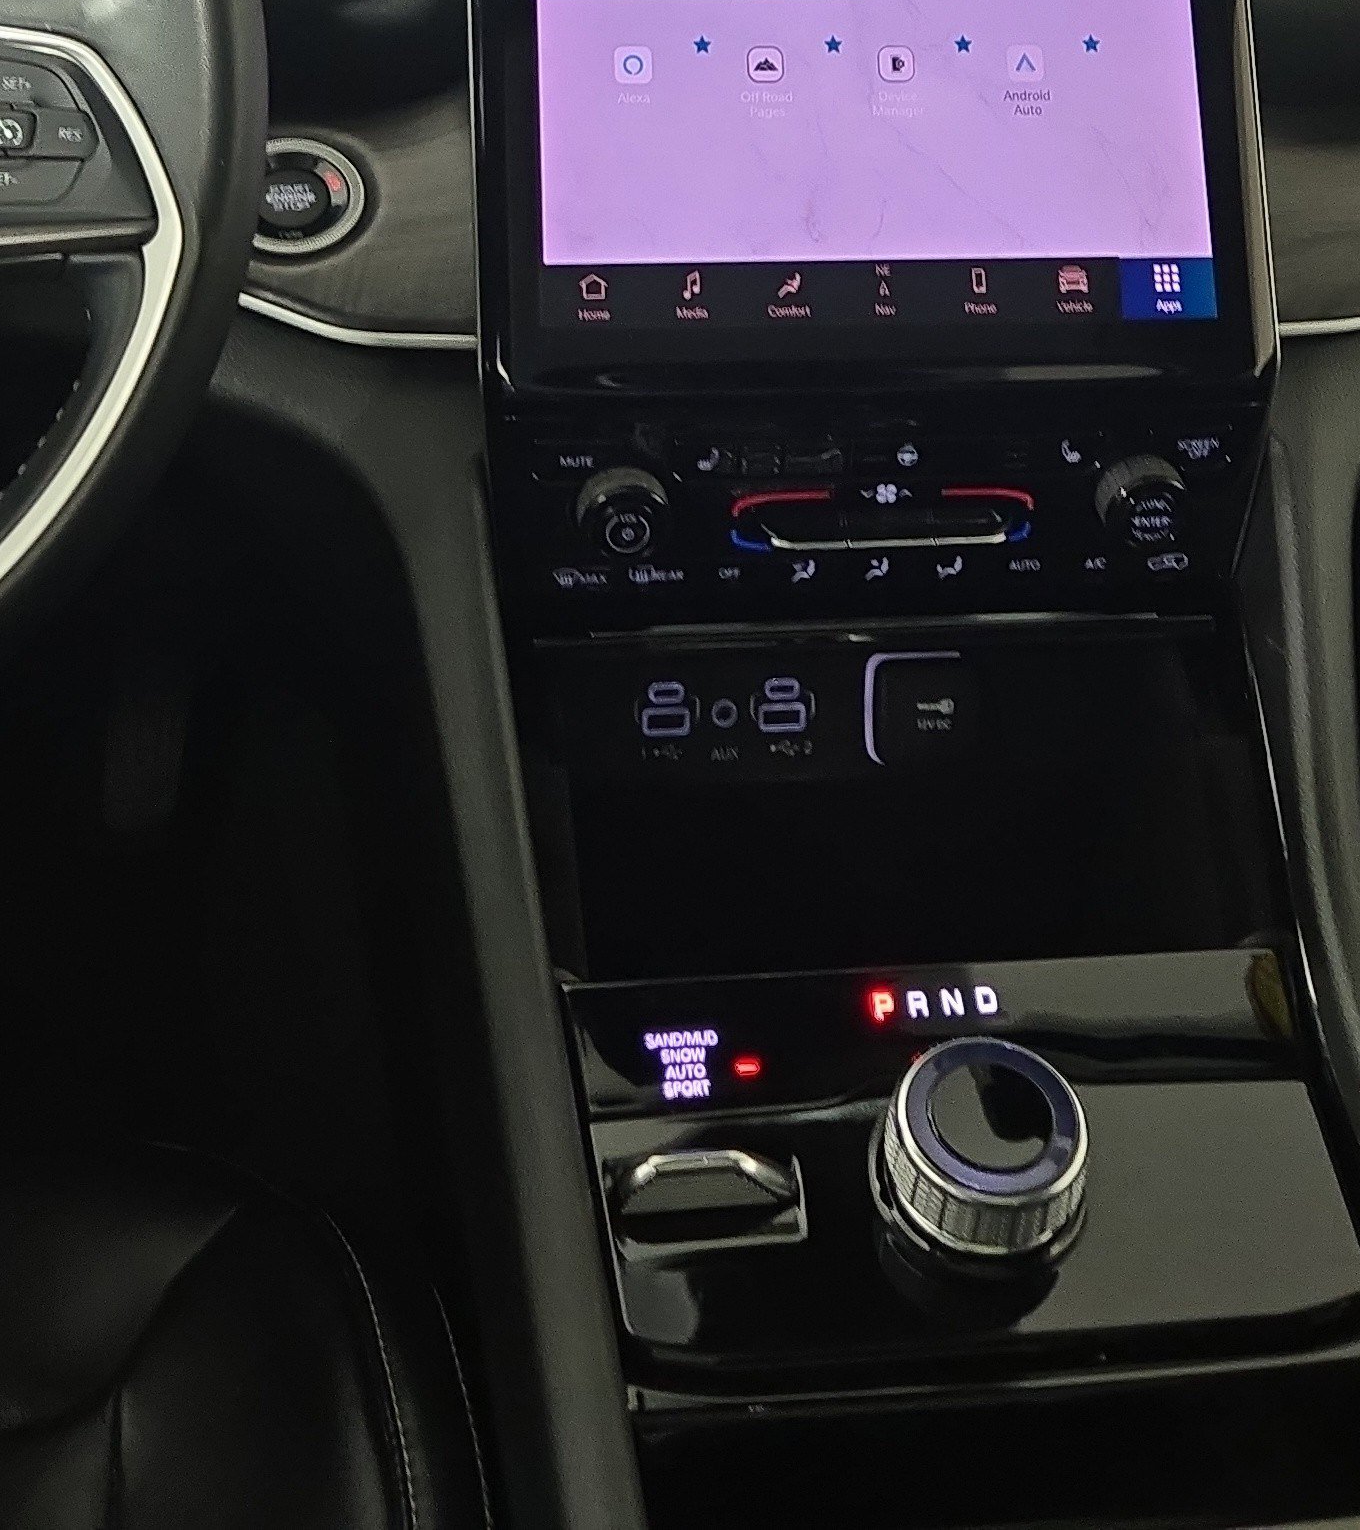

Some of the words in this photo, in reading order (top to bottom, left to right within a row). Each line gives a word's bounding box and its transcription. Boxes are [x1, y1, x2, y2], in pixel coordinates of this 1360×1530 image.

[617, 92, 651, 105] Alexa
[1003, 89, 1051, 103] Android
[1013, 103, 1043, 117] Auto
[767, 303, 812, 319] Comfort
[1155, 298, 1183, 316] Apps
[872, 991, 895, 1020] P
[906, 990, 929, 1019] R
[939, 988, 966, 1017] N
[974, 986, 998, 1015] D
[644, 1030, 718, 1050] SAND/MUD
[661, 1047, 706, 1064] SNOW
[665, 1063, 707, 1080] AUTO
[663, 1079, 711, 1099] SPORT
